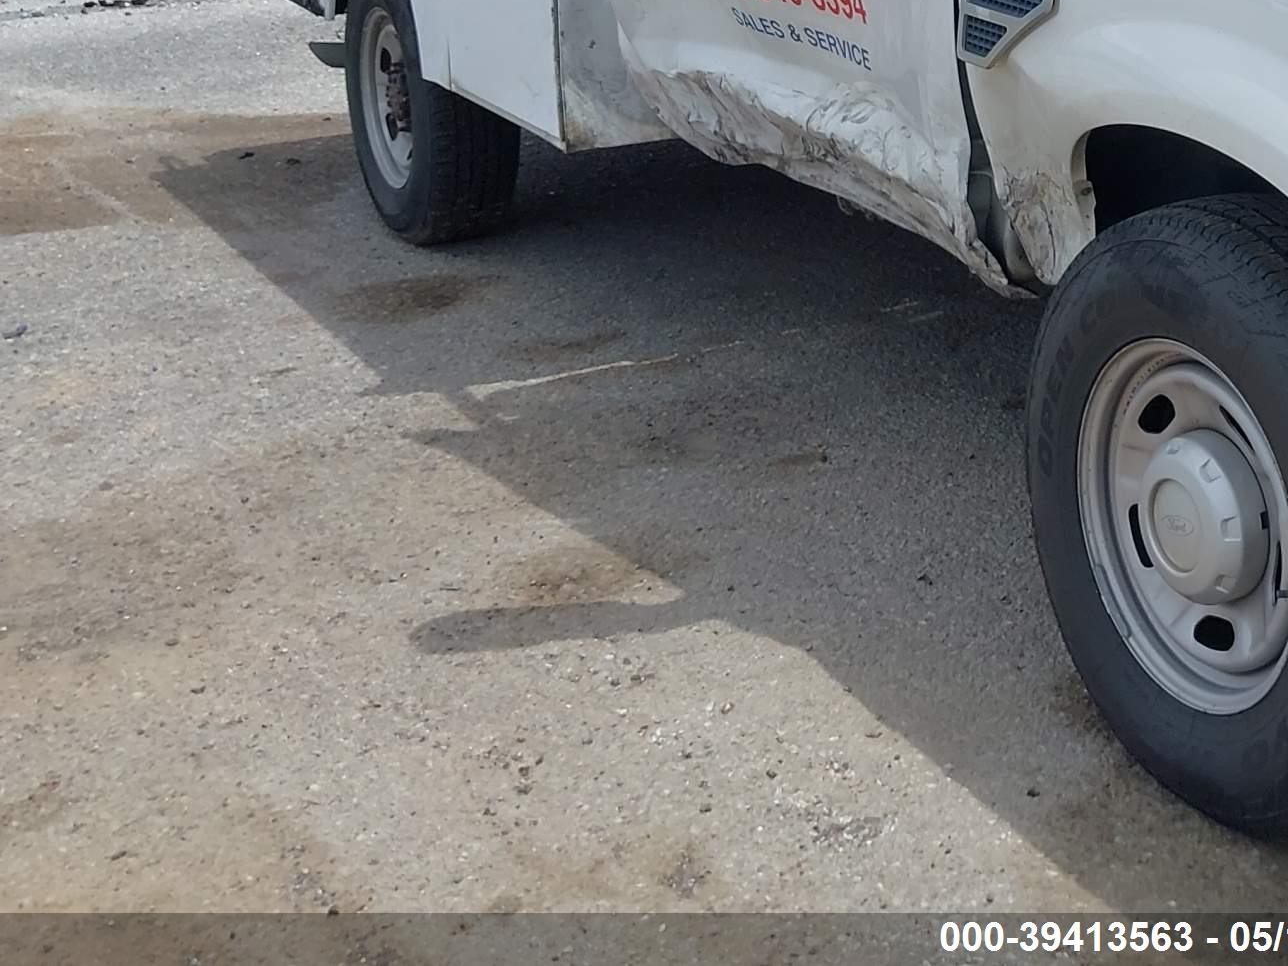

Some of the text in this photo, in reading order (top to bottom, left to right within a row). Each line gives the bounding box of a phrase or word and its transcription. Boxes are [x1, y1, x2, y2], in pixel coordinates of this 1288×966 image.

[731, 6, 872, 71] SALES & SERVICE
